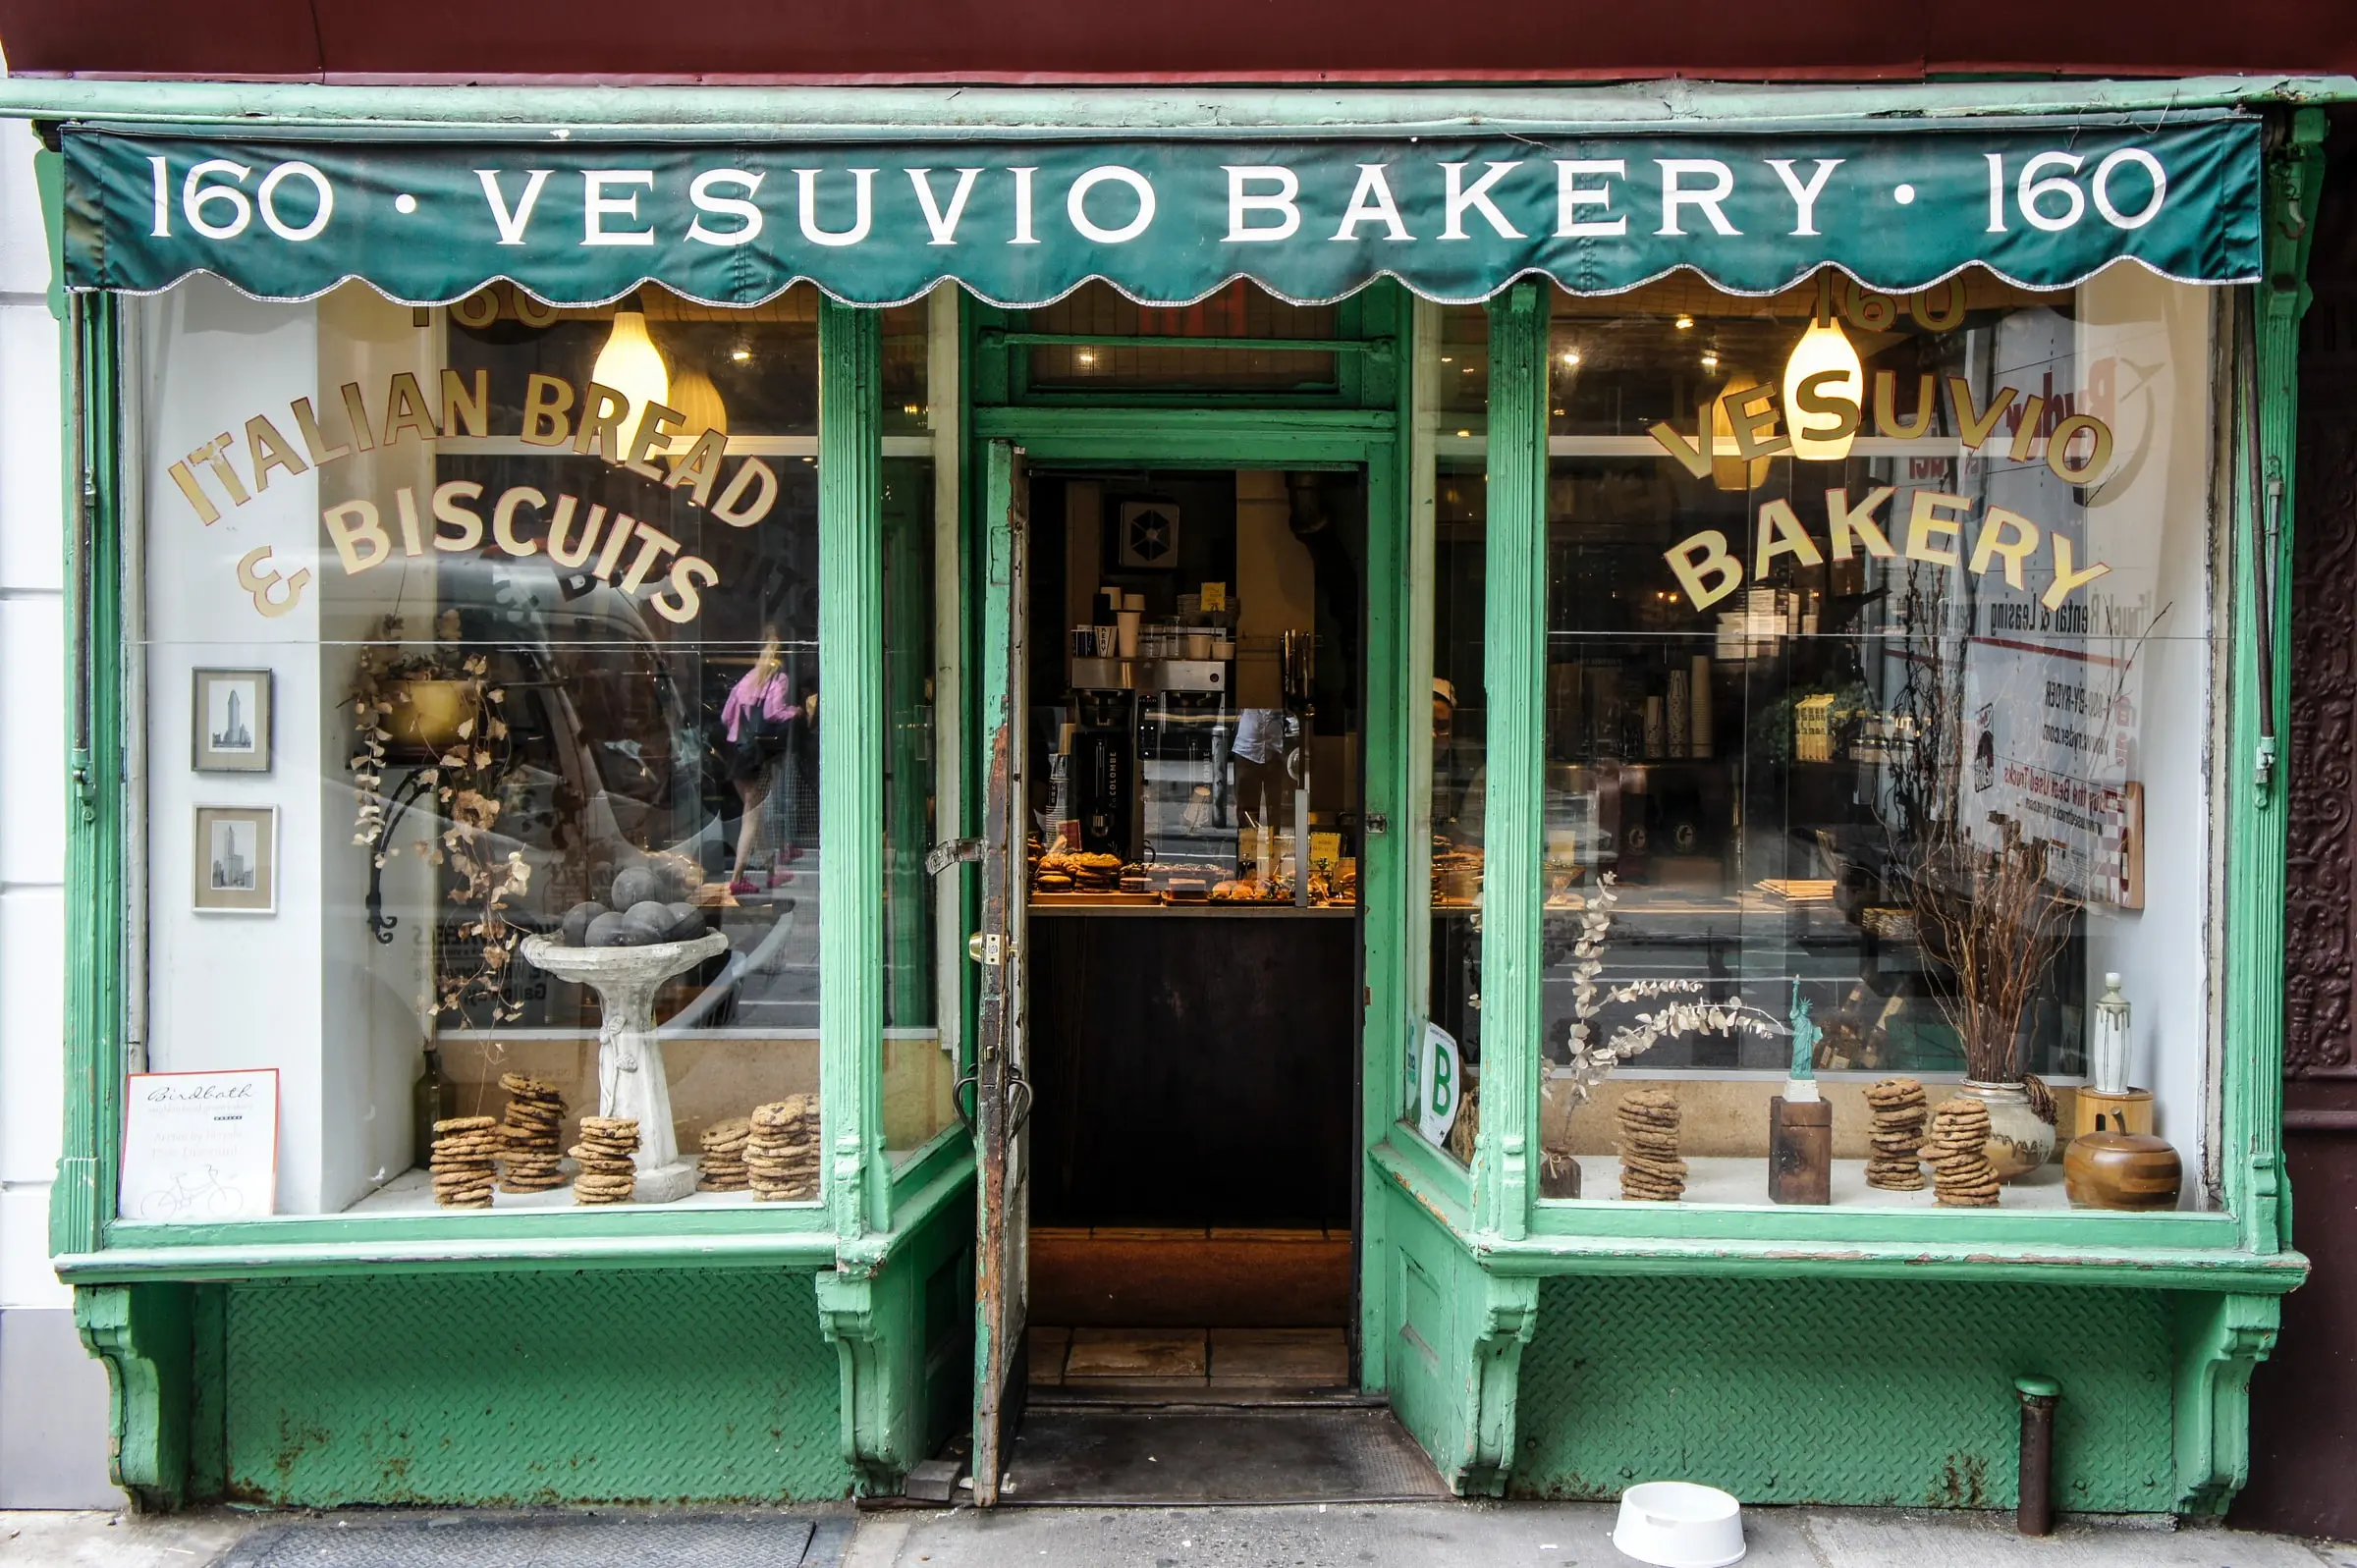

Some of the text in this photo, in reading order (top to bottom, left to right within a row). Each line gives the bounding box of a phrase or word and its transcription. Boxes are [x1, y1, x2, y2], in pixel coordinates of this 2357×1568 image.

[146, 147, 2166, 247] 160 VESUVIO BAKERY 160
[167, 369, 779, 528] ITALIAN BREAD
[1647, 369, 2113, 485] VESUVIO
[236, 479, 720, 624] & BISCUITS
[1663, 485, 2112, 614] BAKERY
[147, 1083, 252, 1102] Birdbath
[1432, 1043, 1452, 1117] B
